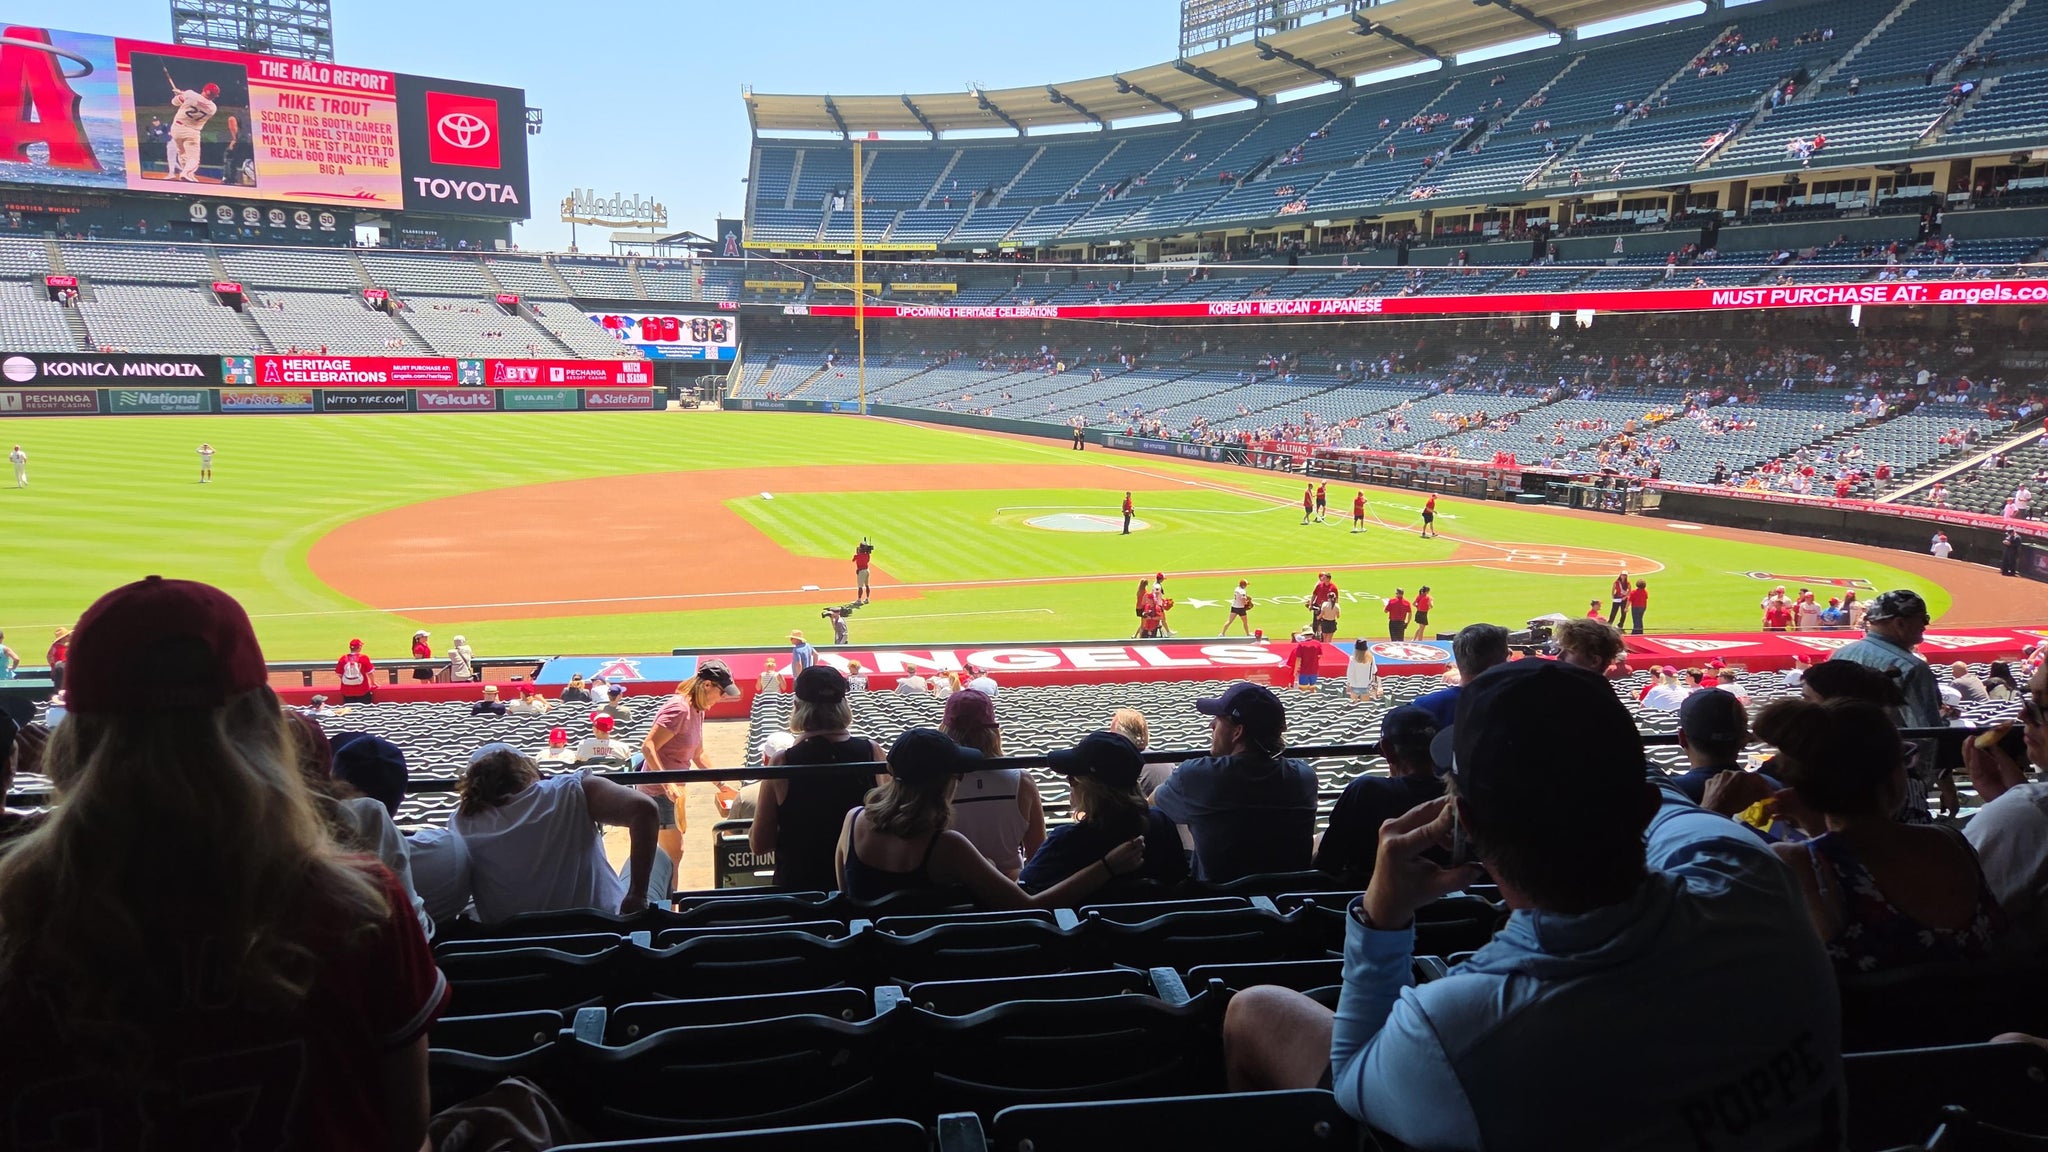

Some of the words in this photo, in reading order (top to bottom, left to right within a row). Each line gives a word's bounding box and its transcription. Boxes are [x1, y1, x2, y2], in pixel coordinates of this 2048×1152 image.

[259, 60, 289, 79] THE
[292, 63, 330, 84] HALO
[333, 69, 388, 91] REPORT
[278, 93, 316, 111] MIKE
[321, 97, 371, 118] TROUT
[185, 105, 207, 121] 27
[261, 110, 300, 125] SCORED
[303, 115, 319, 127] HIS
[322, 117, 353, 131] 600TH
[356, 121, 392, 135] CAREER
[261, 123, 282, 134] RUN
[285, 125, 298, 136] AT
[302, 127, 333, 140] ANGEL
[336, 131, 378, 145] STADIUM
[381, 135, 393, 146] ON
[262, 134, 283, 146] MAY
[302, 139, 321, 151] THE
[324, 140, 340, 152] 1ST
[343, 143, 380, 157] PLAYER
[383, 146, 395, 158] TO
[270, 147, 303, 160] REACH
[306, 150, 325, 162] 600
[327, 152, 353, 166] RUNS
[356, 156, 368, 167] AT
[370, 157, 389, 169] THE
[319, 163, 335, 175] BIG
[338, 165, 345, 176] A
[413, 176, 519, 204] TOYOTA
[574, 187, 653, 219] Modelo
[194, 207, 203, 216] 11
[219, 208, 232, 217] 26
[245, 210, 258, 219] 29
[271, 212, 284, 221] 30
[295, 213, 309, 222] 42
[321, 216, 333, 225] 50
[49, 277, 73, 286] Coca-Cola
[1711, 289, 1767, 305] MUST
[1770, 286, 1887, 304] PURCHASE
[1893, 286, 1928, 302] AT:
[896, 307, 950, 317] UPCOMING
[952, 307, 997, 318] HERITAGE
[998, 307, 1058, 318] CELEBRATIONS
[1208, 301, 1251, 316] KOREAN
[1259, 300, 1310, 314] MEXICAN
[1318, 298, 1383, 313] JAPANESE
[43, 362, 119, 377] KONICA
[122, 363, 205, 377] MINOLTA
[243, 359, 251, 368] 2
[283, 359, 351, 371] HERITAGE
[475, 362, 481, 370] 2
[622, 362, 641, 373] WATCH
[244, 375, 253, 384] 0
[284, 372, 387, 382] CELEBRATIONS
[506, 367, 538, 380] BTV
[616, 373, 627, 384] ALL
[627, 373, 648, 384] SEASON
[476, 377, 482, 385] 2
[25, 395, 91, 403] PECHANGA
[138, 392, 200, 405] National
[226, 393, 281, 407] Surfside
[326, 394, 358, 404] NITTO
[360, 394, 405, 404] TIRE.COM
[422, 393, 491, 406] Yakult
[1183, 445, 1200, 457] Modelo
[1276, 443, 1309, 457] SALINAS,
[806, 643, 1285, 674] ANGELS
[592, 746, 614, 756] TROUT
[728, 850, 776, 868] SECTION
